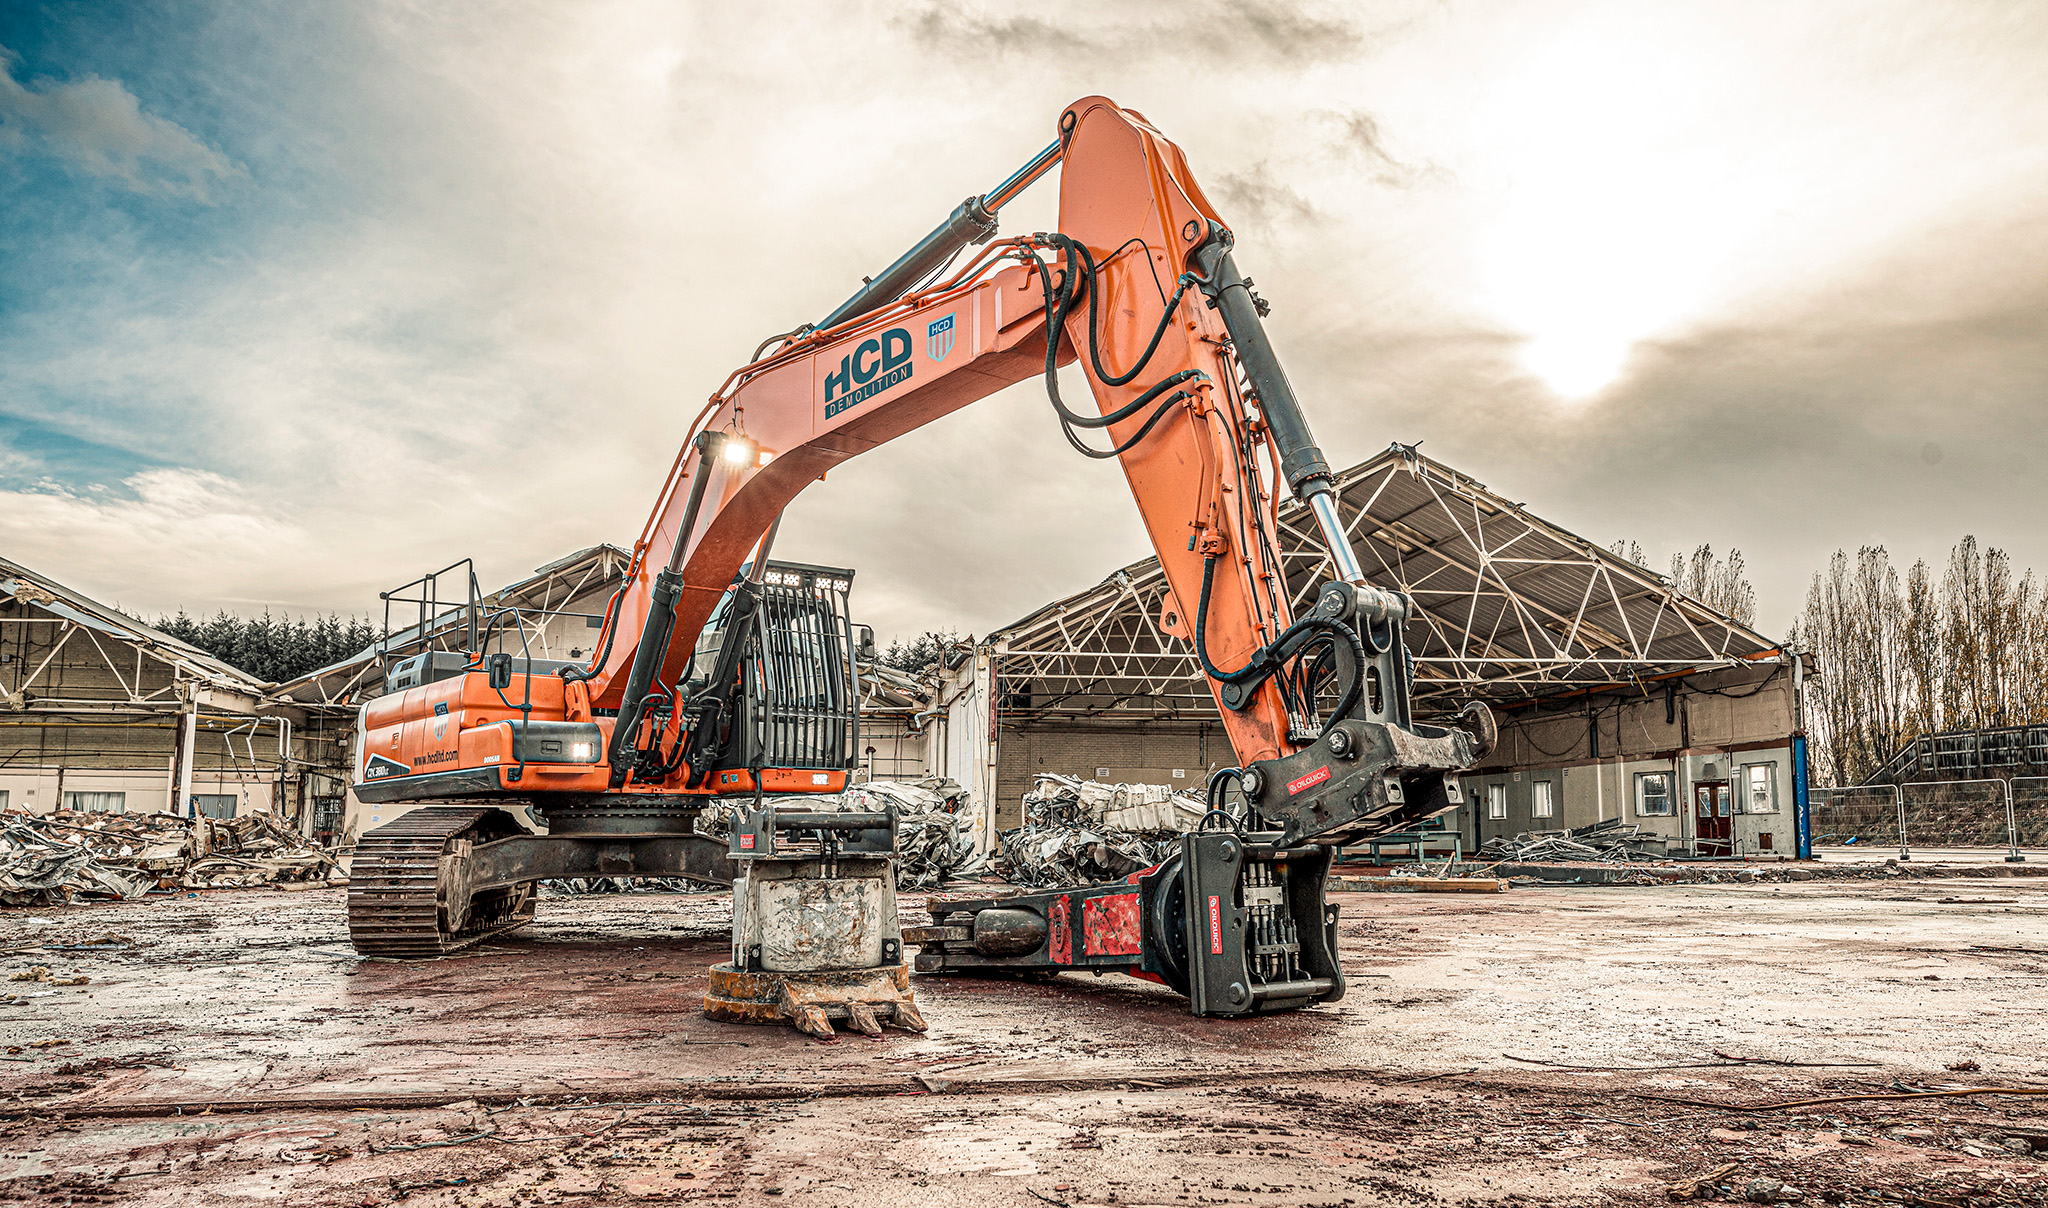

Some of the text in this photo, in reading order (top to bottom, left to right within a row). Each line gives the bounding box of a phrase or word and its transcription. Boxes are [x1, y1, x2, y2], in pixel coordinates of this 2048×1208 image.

[932, 319, 950, 335] HCD
[825, 328, 912, 403] HCD
[830, 366, 908, 416] DEMOLITION
[413, 749, 458, 766] www.hcdltd.com
[483, 754, 501, 764] DOOSAN
[1296, 770, 1326, 789] OILQUICK
[1211, 908, 1219, 949] OILQUICK
